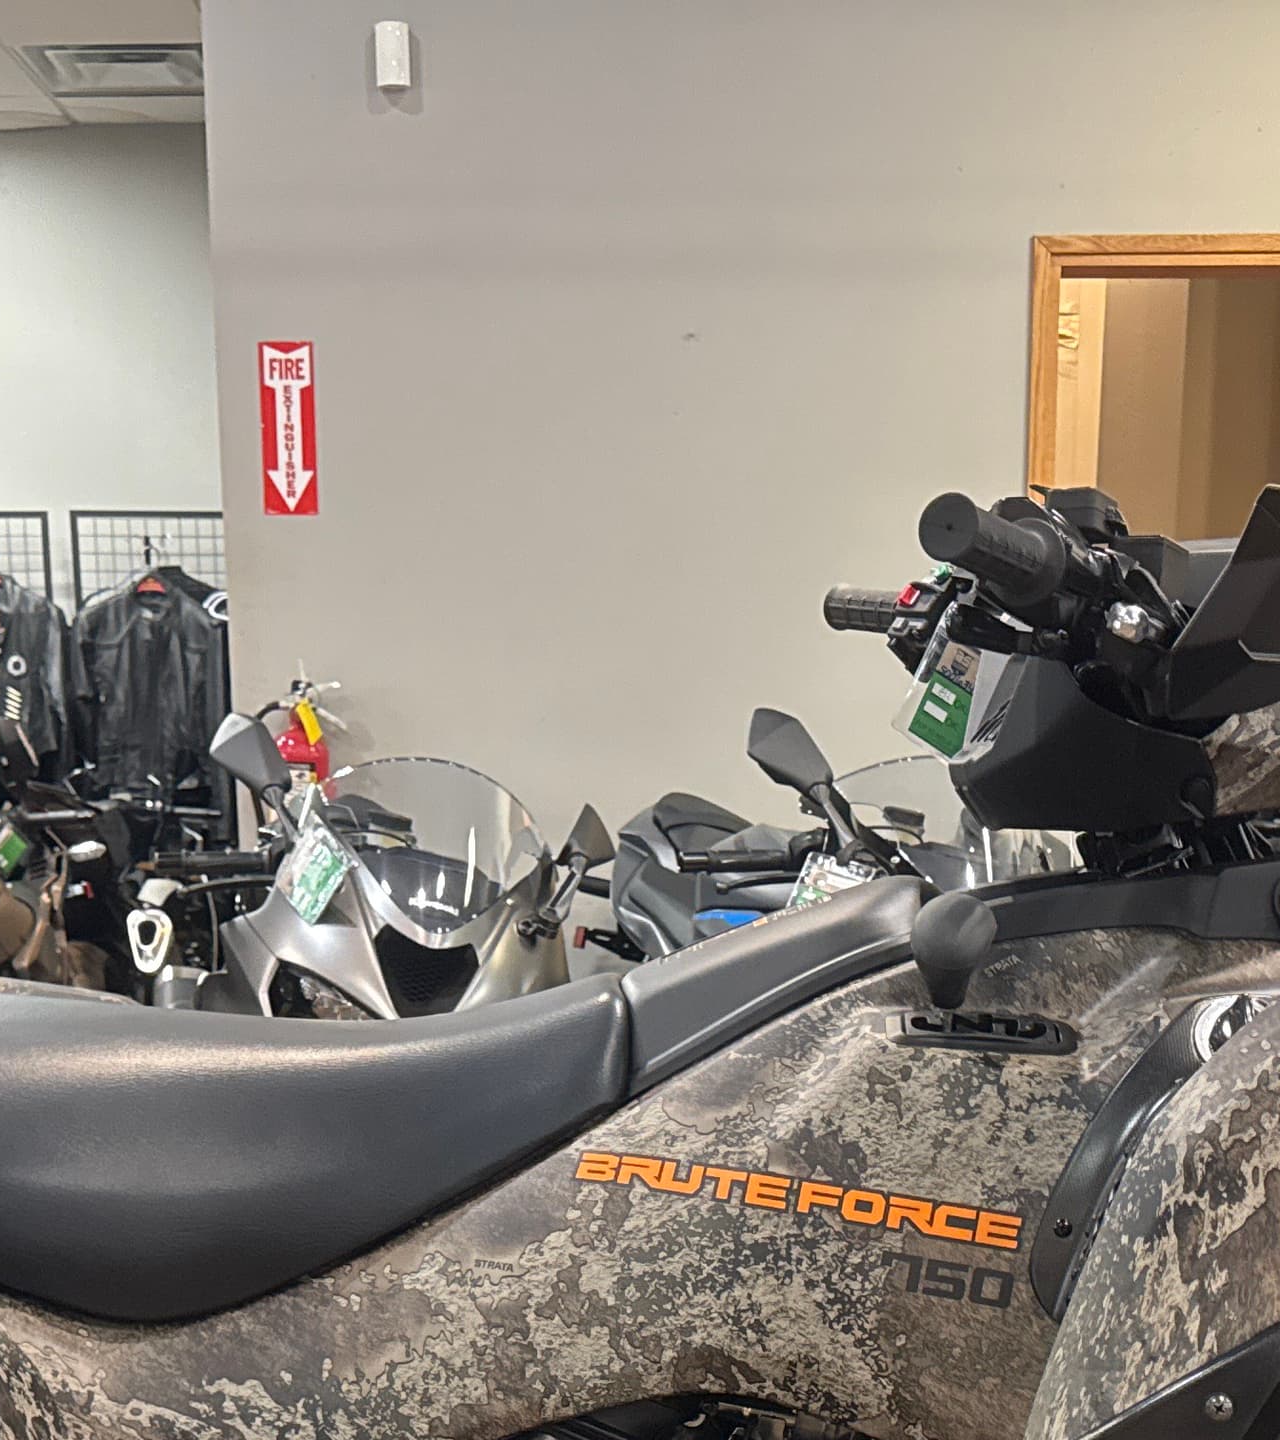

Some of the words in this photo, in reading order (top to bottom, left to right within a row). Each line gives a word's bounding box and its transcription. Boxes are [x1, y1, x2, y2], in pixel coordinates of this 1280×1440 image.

[268, 358, 306, 381] FIRE
[282, 385, 297, 498] EXTINGUISHER
[983, 954, 1024, 978] STRATA
[574, 1151, 791, 1210] BRUTE
[796, 1181, 1023, 1249] FORCE
[474, 1259, 514, 1273] STRATA
[881, 1251, 1015, 1308] 750
